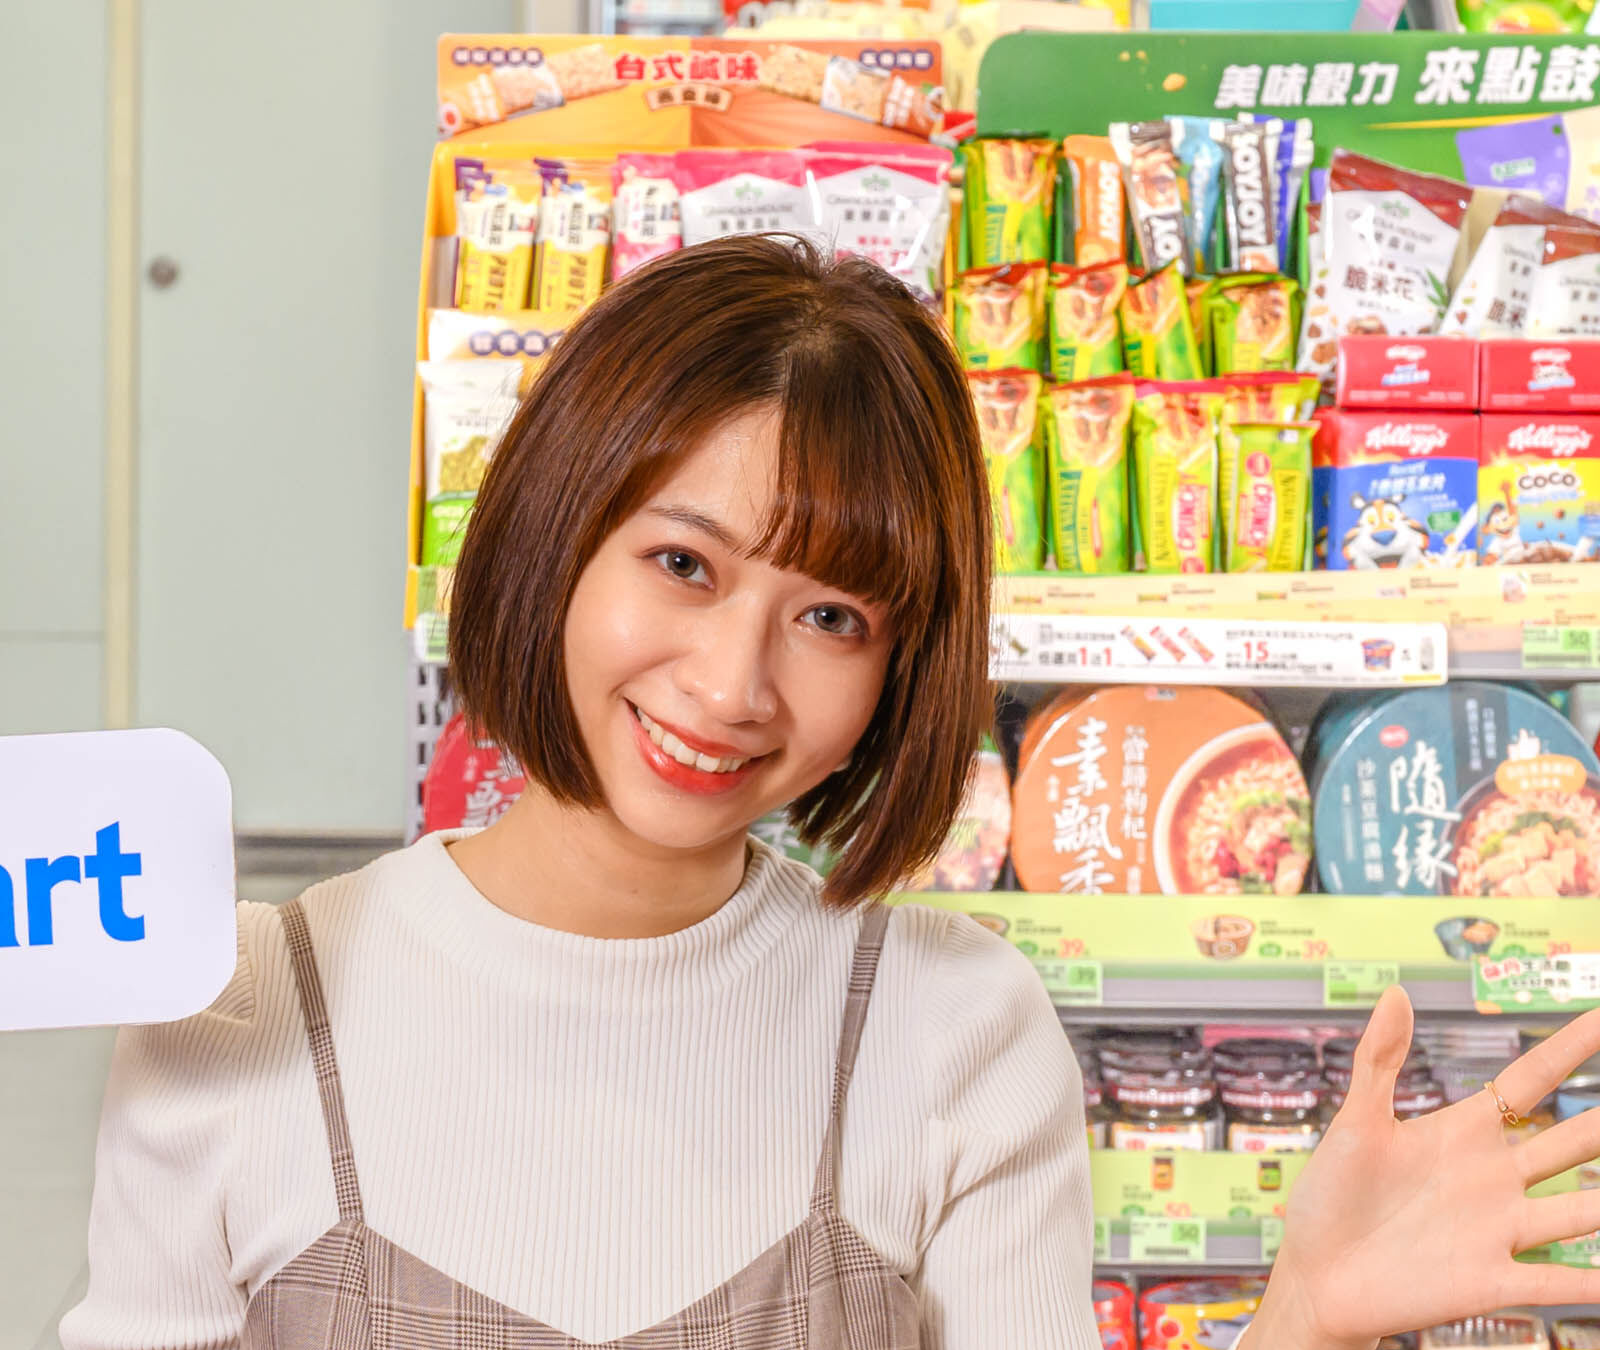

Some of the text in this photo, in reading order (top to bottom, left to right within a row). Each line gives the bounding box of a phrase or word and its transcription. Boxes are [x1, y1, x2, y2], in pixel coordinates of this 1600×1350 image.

[1214, 62, 1399, 108] 美味穀力
[1518, 471, 1576, 490] COCO
